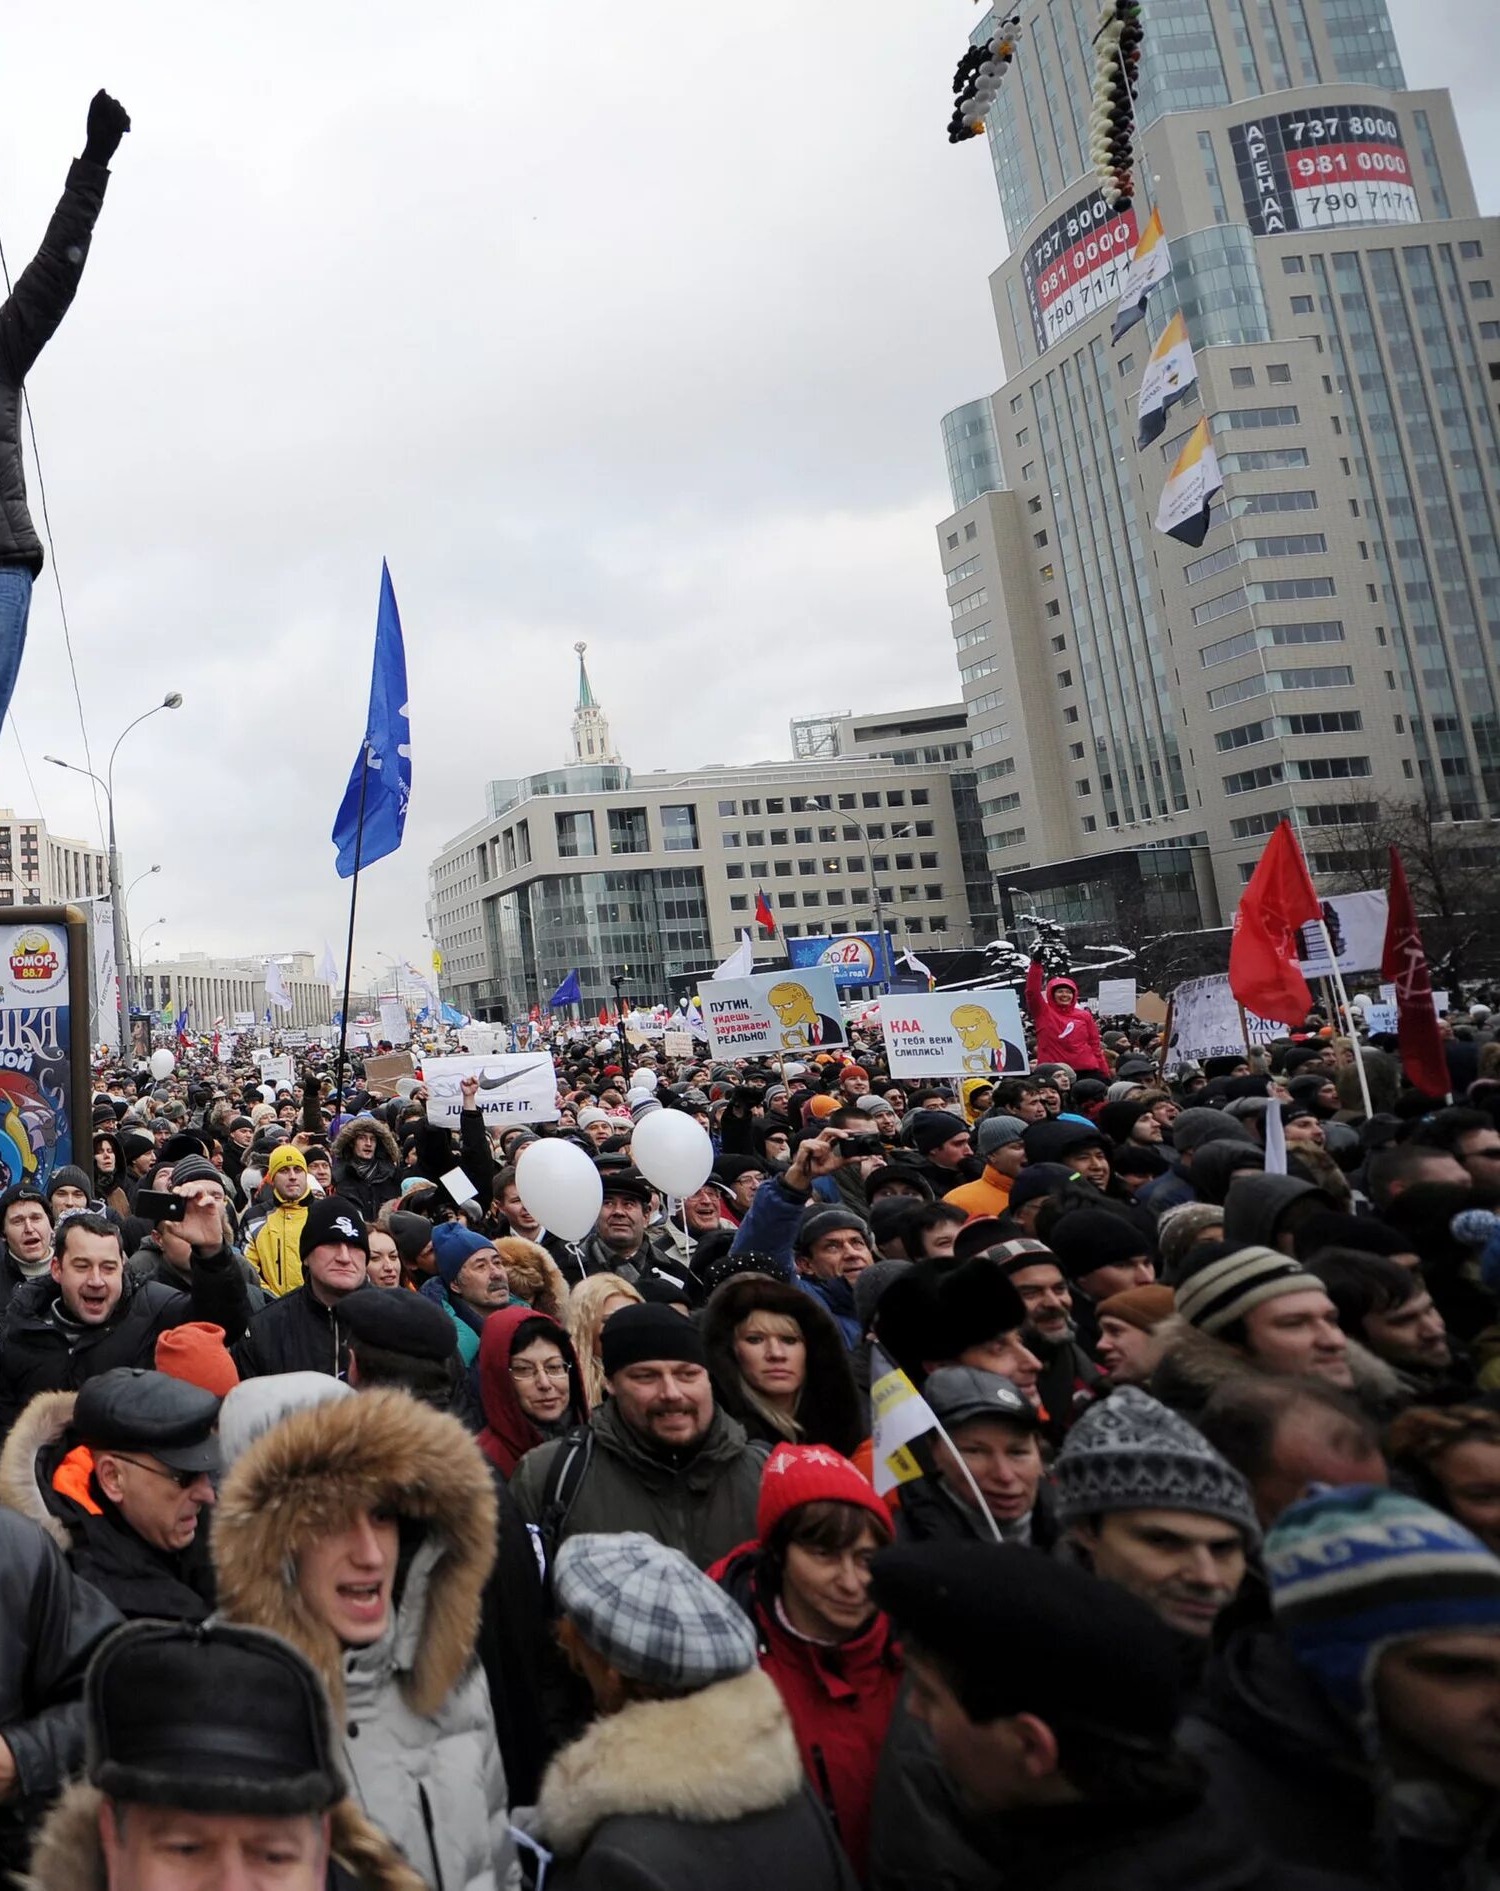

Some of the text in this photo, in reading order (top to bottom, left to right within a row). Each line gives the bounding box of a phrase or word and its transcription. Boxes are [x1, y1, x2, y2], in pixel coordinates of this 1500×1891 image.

[1289, 117, 1397, 141] 737 8000
[1297, 152, 1406, 176] 981 0000
[1247, 125, 1284, 231] АРЕНДА
[1307, 191, 1412, 214] 790 7171
[1035, 200, 1114, 267] 737 800
[1041, 223, 1130, 298] 981 0000
[1048, 299, 1073, 333] 790
[12, 954, 52, 967] ЮМОР
[823, 943, 860, 964] 2012
[22, 968, 44, 978] 88.7
[709, 998, 752, 1013] ПУТИН,
[715, 1019, 771, 1035] зауважаем!
[717, 1031, 767, 1045] РЕАЛЬНО!
[892, 1035, 953, 1048] у тебя веки
[894, 1046, 945, 1057] слиплись!
[481, 1102, 514, 1114] HATE
[518, 1101, 534, 1112] IT.
